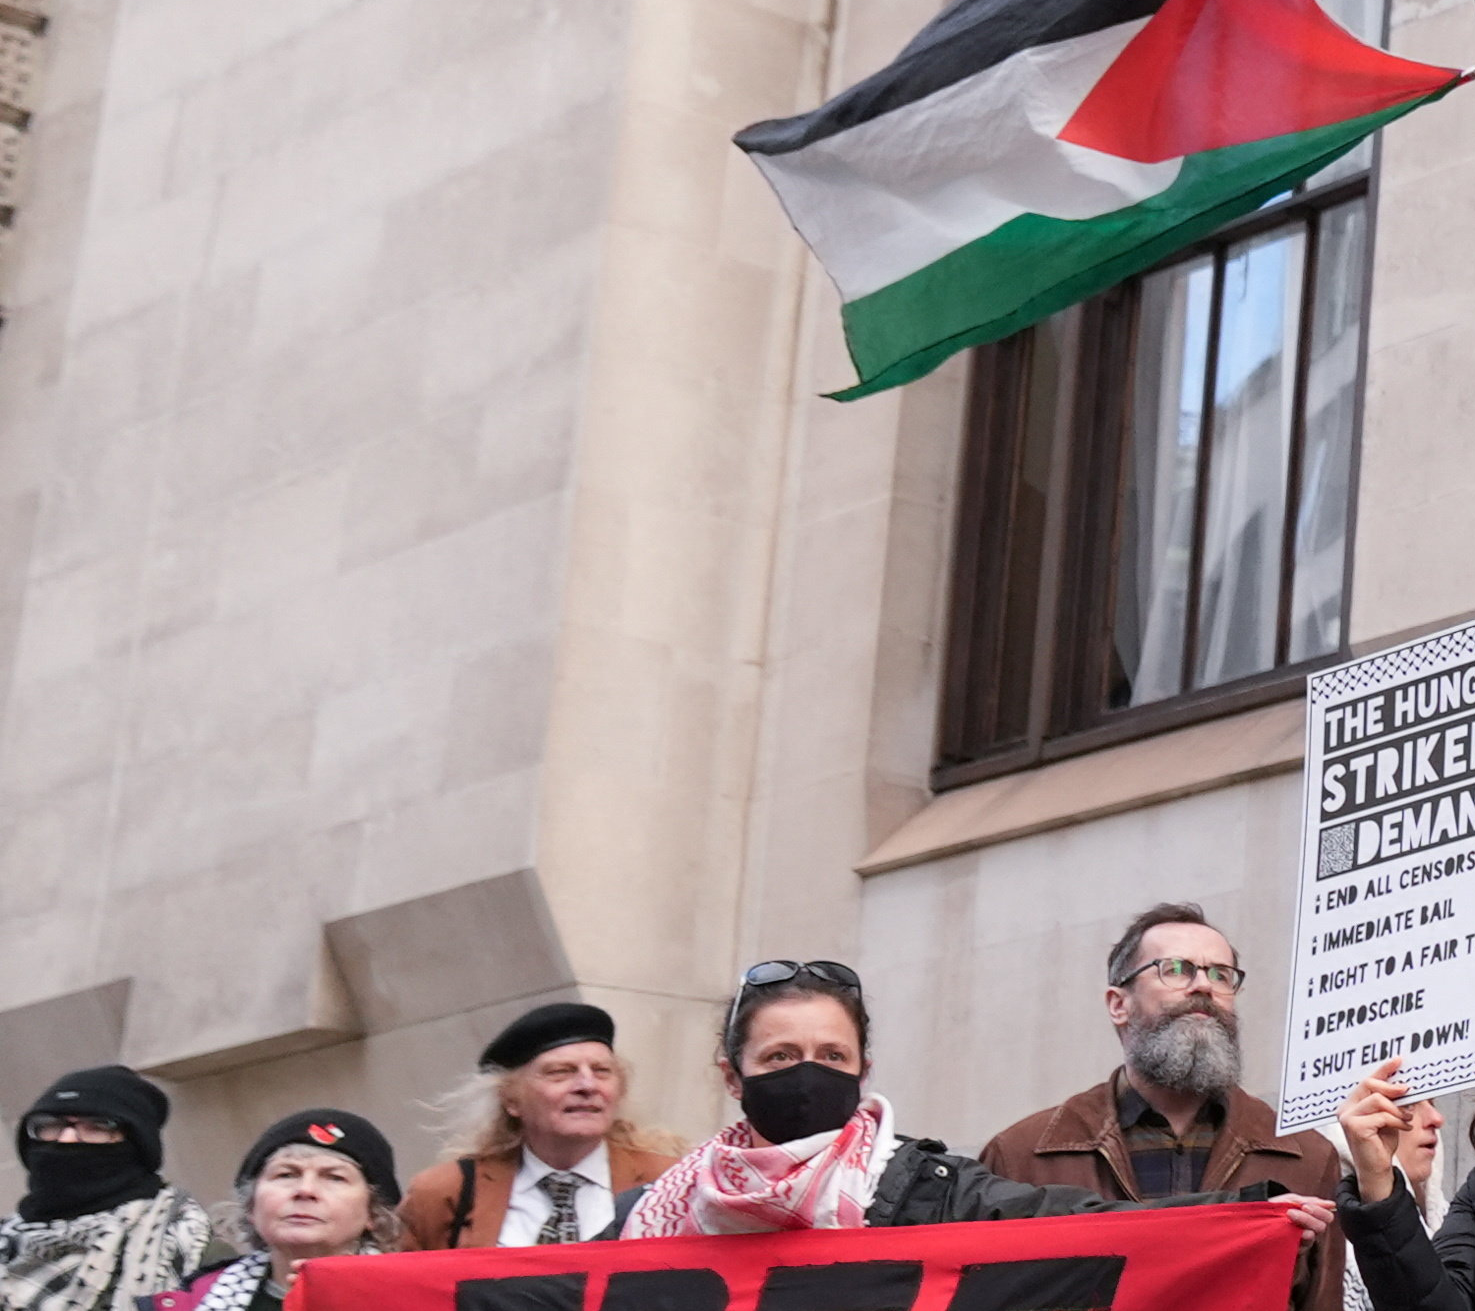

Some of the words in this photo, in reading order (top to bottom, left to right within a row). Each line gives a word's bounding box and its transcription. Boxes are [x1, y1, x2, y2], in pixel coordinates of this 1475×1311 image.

[1325, 695, 1385, 748] THE
[1326, 885, 1358, 911] END
[1364, 875, 1392, 901] ALL
[1323, 909, 1414, 953] IMMEDIATE
[1420, 898, 1455, 926] BAIL
[1319, 963, 1368, 994] RIGHT
[1375, 956, 1396, 979] TO
[1401, 951, 1414, 973] A
[1420, 938, 1458, 967] FAIR
[1316, 989, 1425, 1037] DEPROSCRIBE
[1312, 1048, 1356, 1078] SHUT
[1361, 1035, 1405, 1066] ELBIT
[1410, 1019, 1470, 1053] DOWN!
